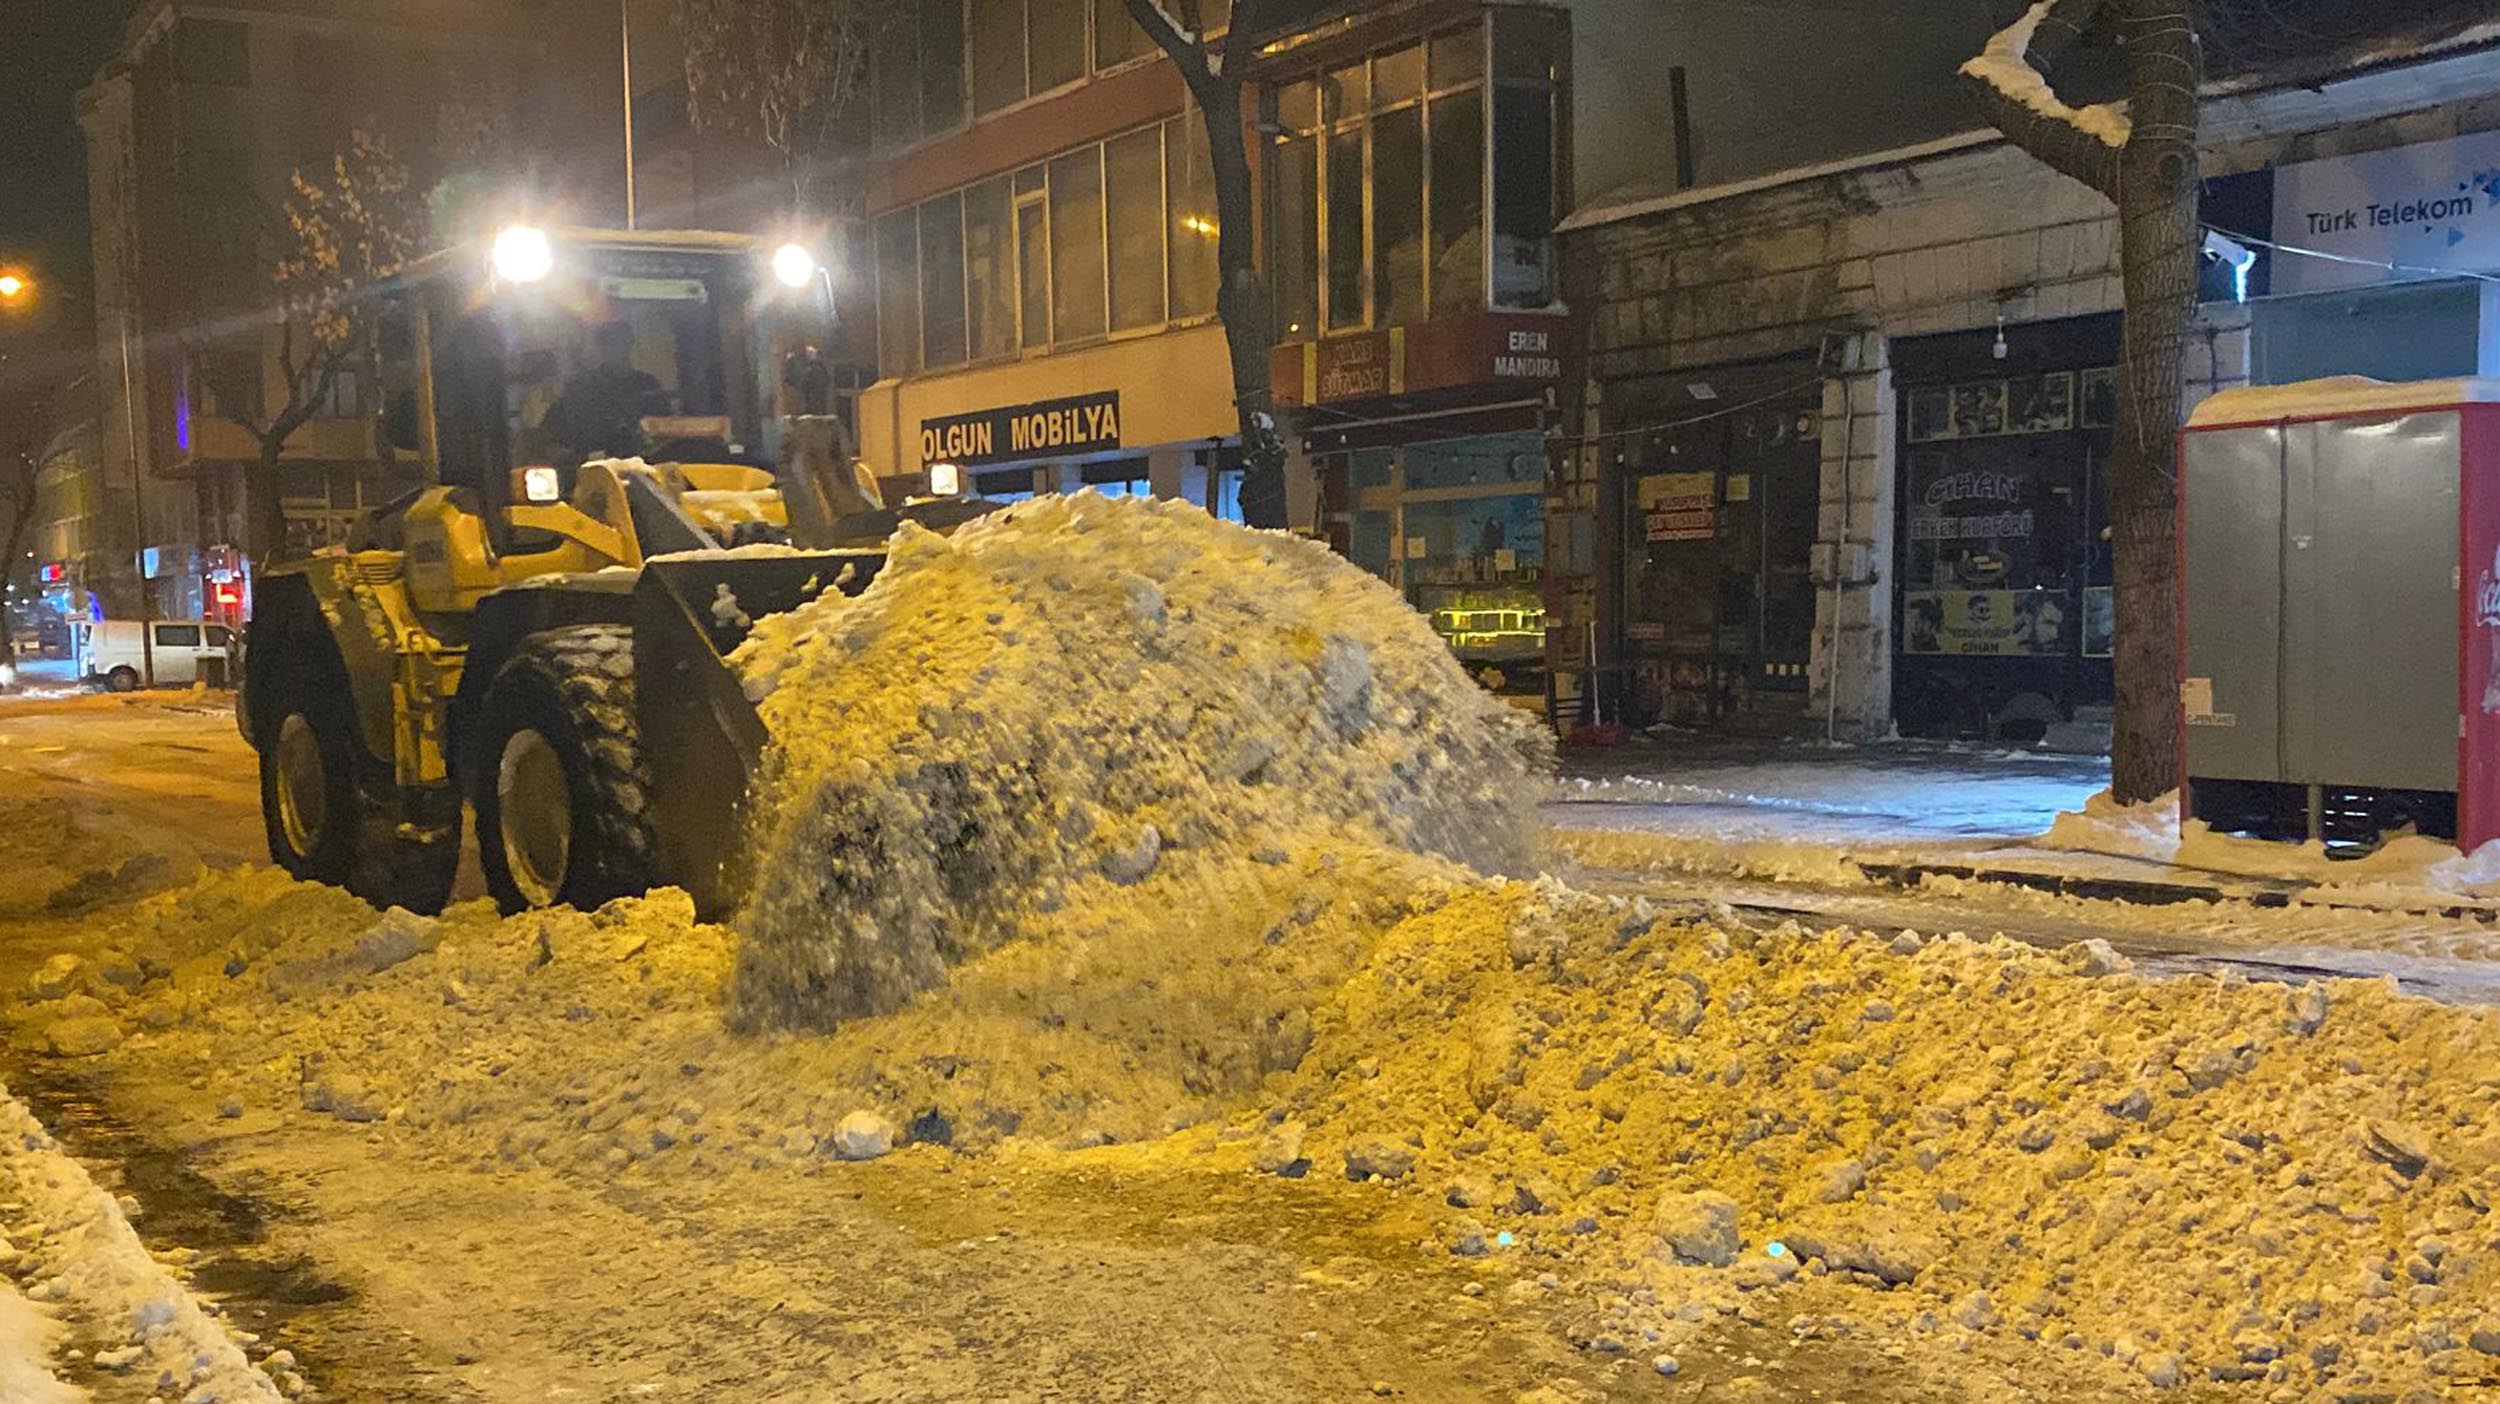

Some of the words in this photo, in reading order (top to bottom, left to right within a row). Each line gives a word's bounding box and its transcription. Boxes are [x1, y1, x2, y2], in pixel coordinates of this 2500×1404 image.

[2306, 208, 2357, 235] Türk
[2366, 196, 2473, 227] Telekom
[1508, 331, 1548, 351] EREN
[1494, 357, 1561, 377] MANDIRA
[921, 421, 992, 461] OLGUN
